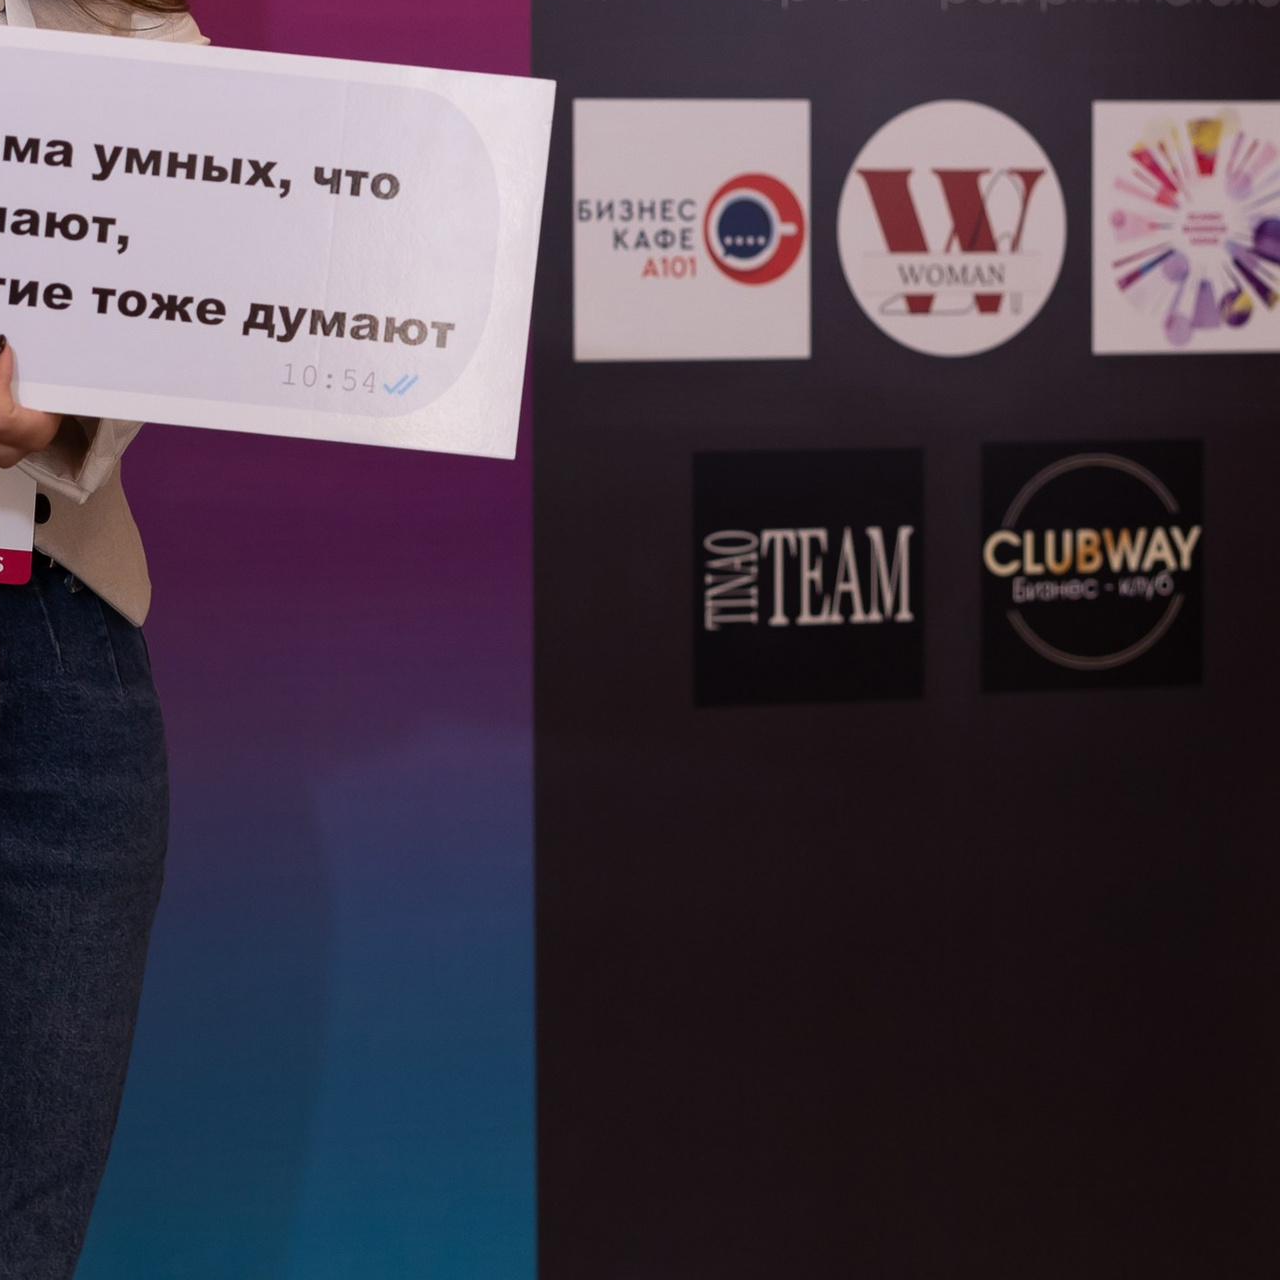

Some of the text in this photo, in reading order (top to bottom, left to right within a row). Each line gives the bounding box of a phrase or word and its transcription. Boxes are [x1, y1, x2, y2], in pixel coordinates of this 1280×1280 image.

[91, 143, 291, 199] умных,
[313, 166, 400, 201] что
[577, 197, 698, 223] БИЗНЕС
[612, 226, 694, 251] КАФЕ
[897, 262, 1007, 287] WOMAN
[91, 286, 227, 327] тоже
[242, 302, 456, 349] думают
[281, 362, 377, 394] 10:54
[982, 524, 1203, 577] CLUBWAY
[759, 524, 915, 627] TEAM
